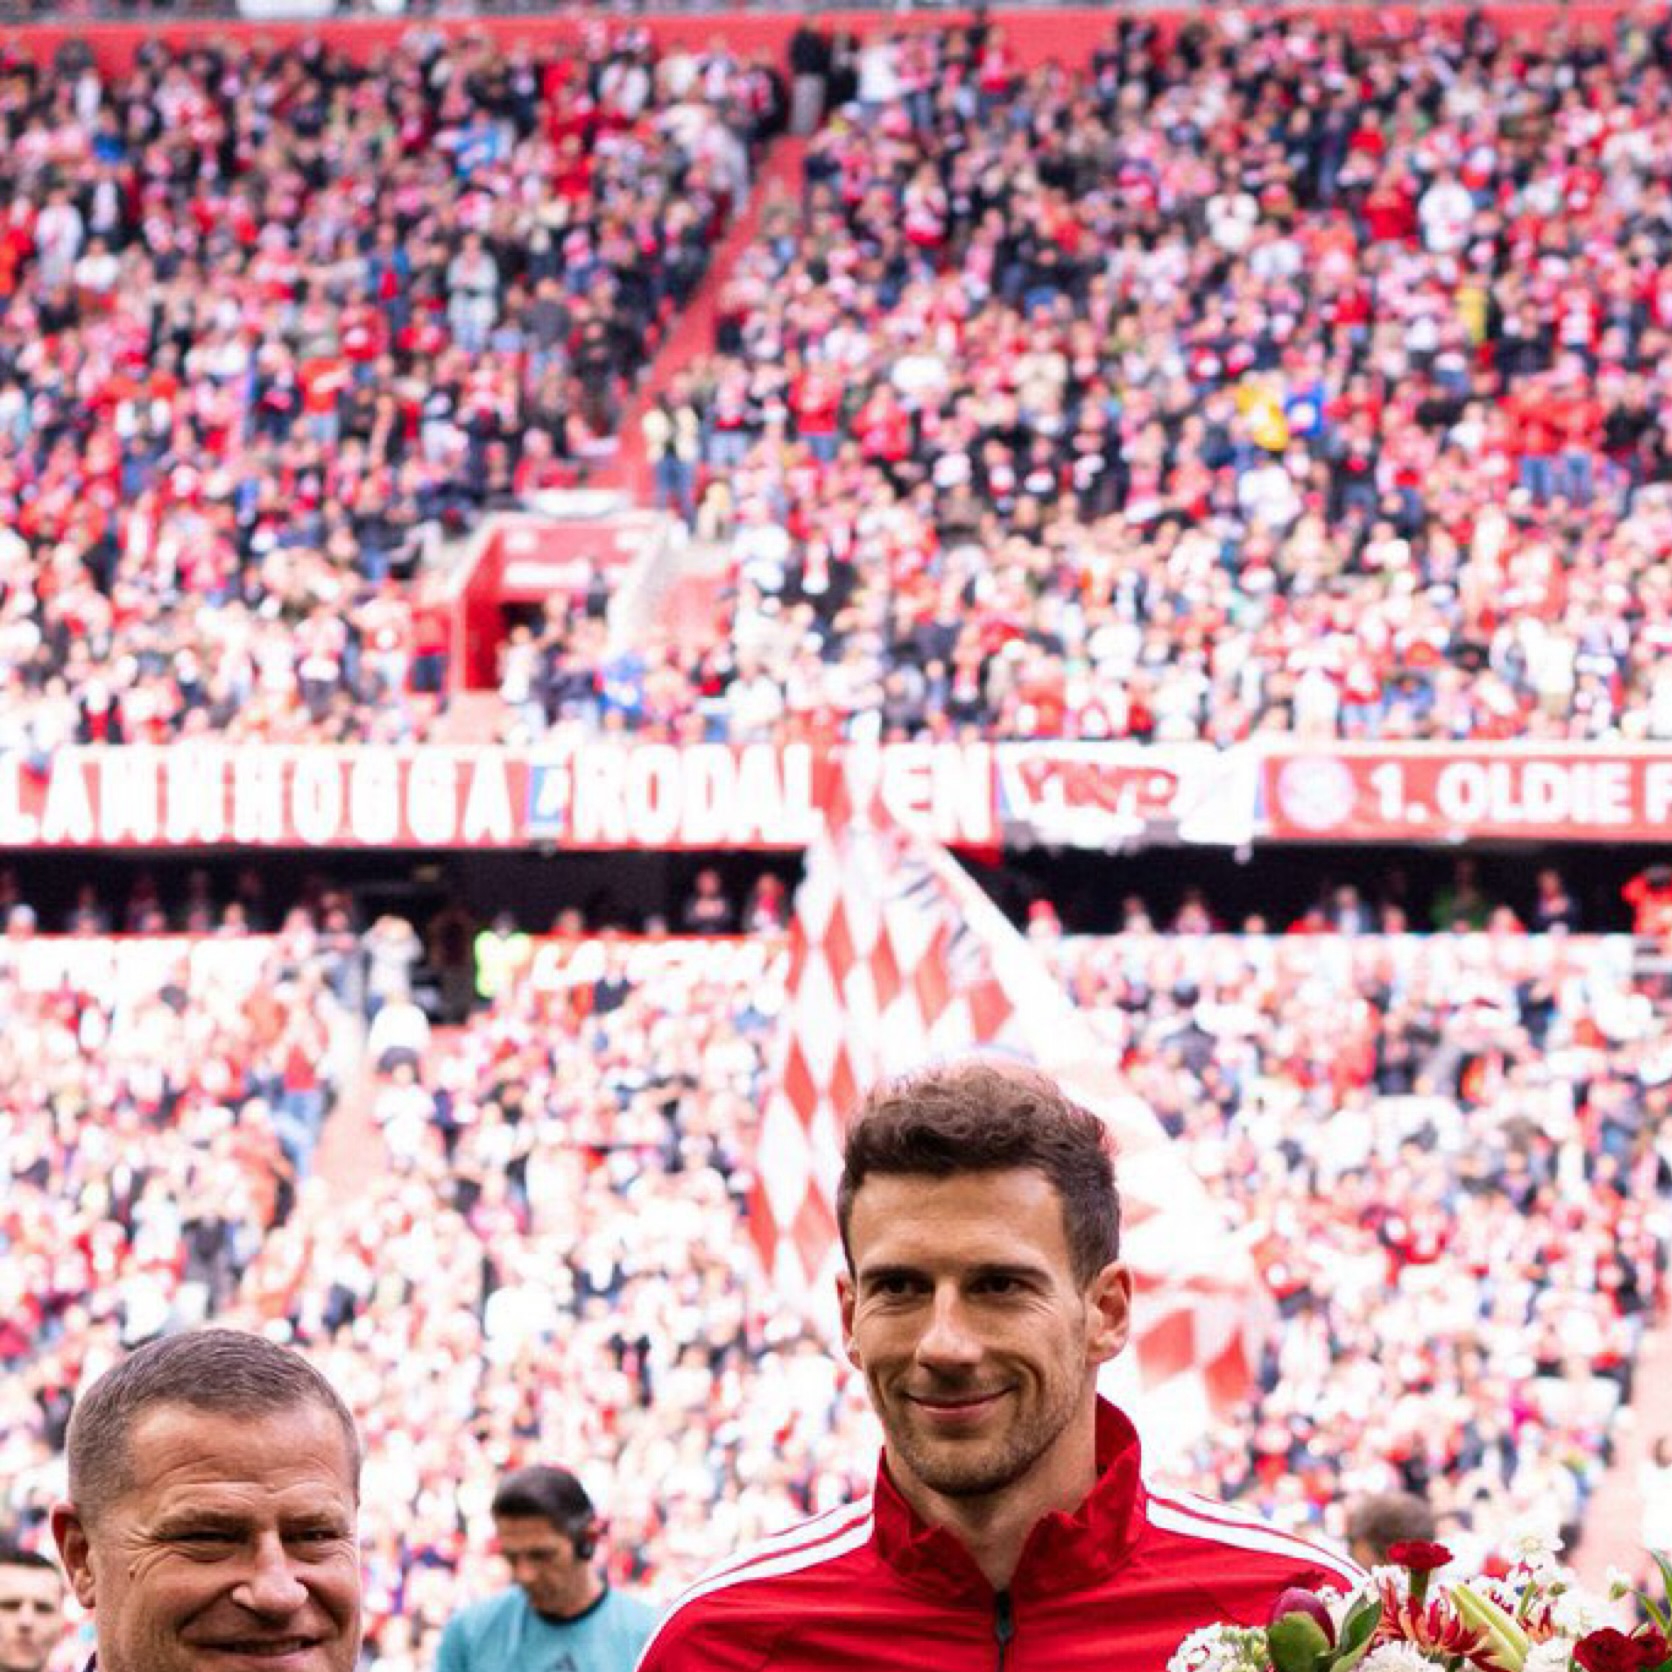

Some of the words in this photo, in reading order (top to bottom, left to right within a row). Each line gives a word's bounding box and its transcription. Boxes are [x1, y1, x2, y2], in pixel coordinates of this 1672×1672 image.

[572, 743, 991, 844] RODALEN
[1369, 761, 1427, 823] 1.
[1436, 761, 1631, 824] OLDIE
